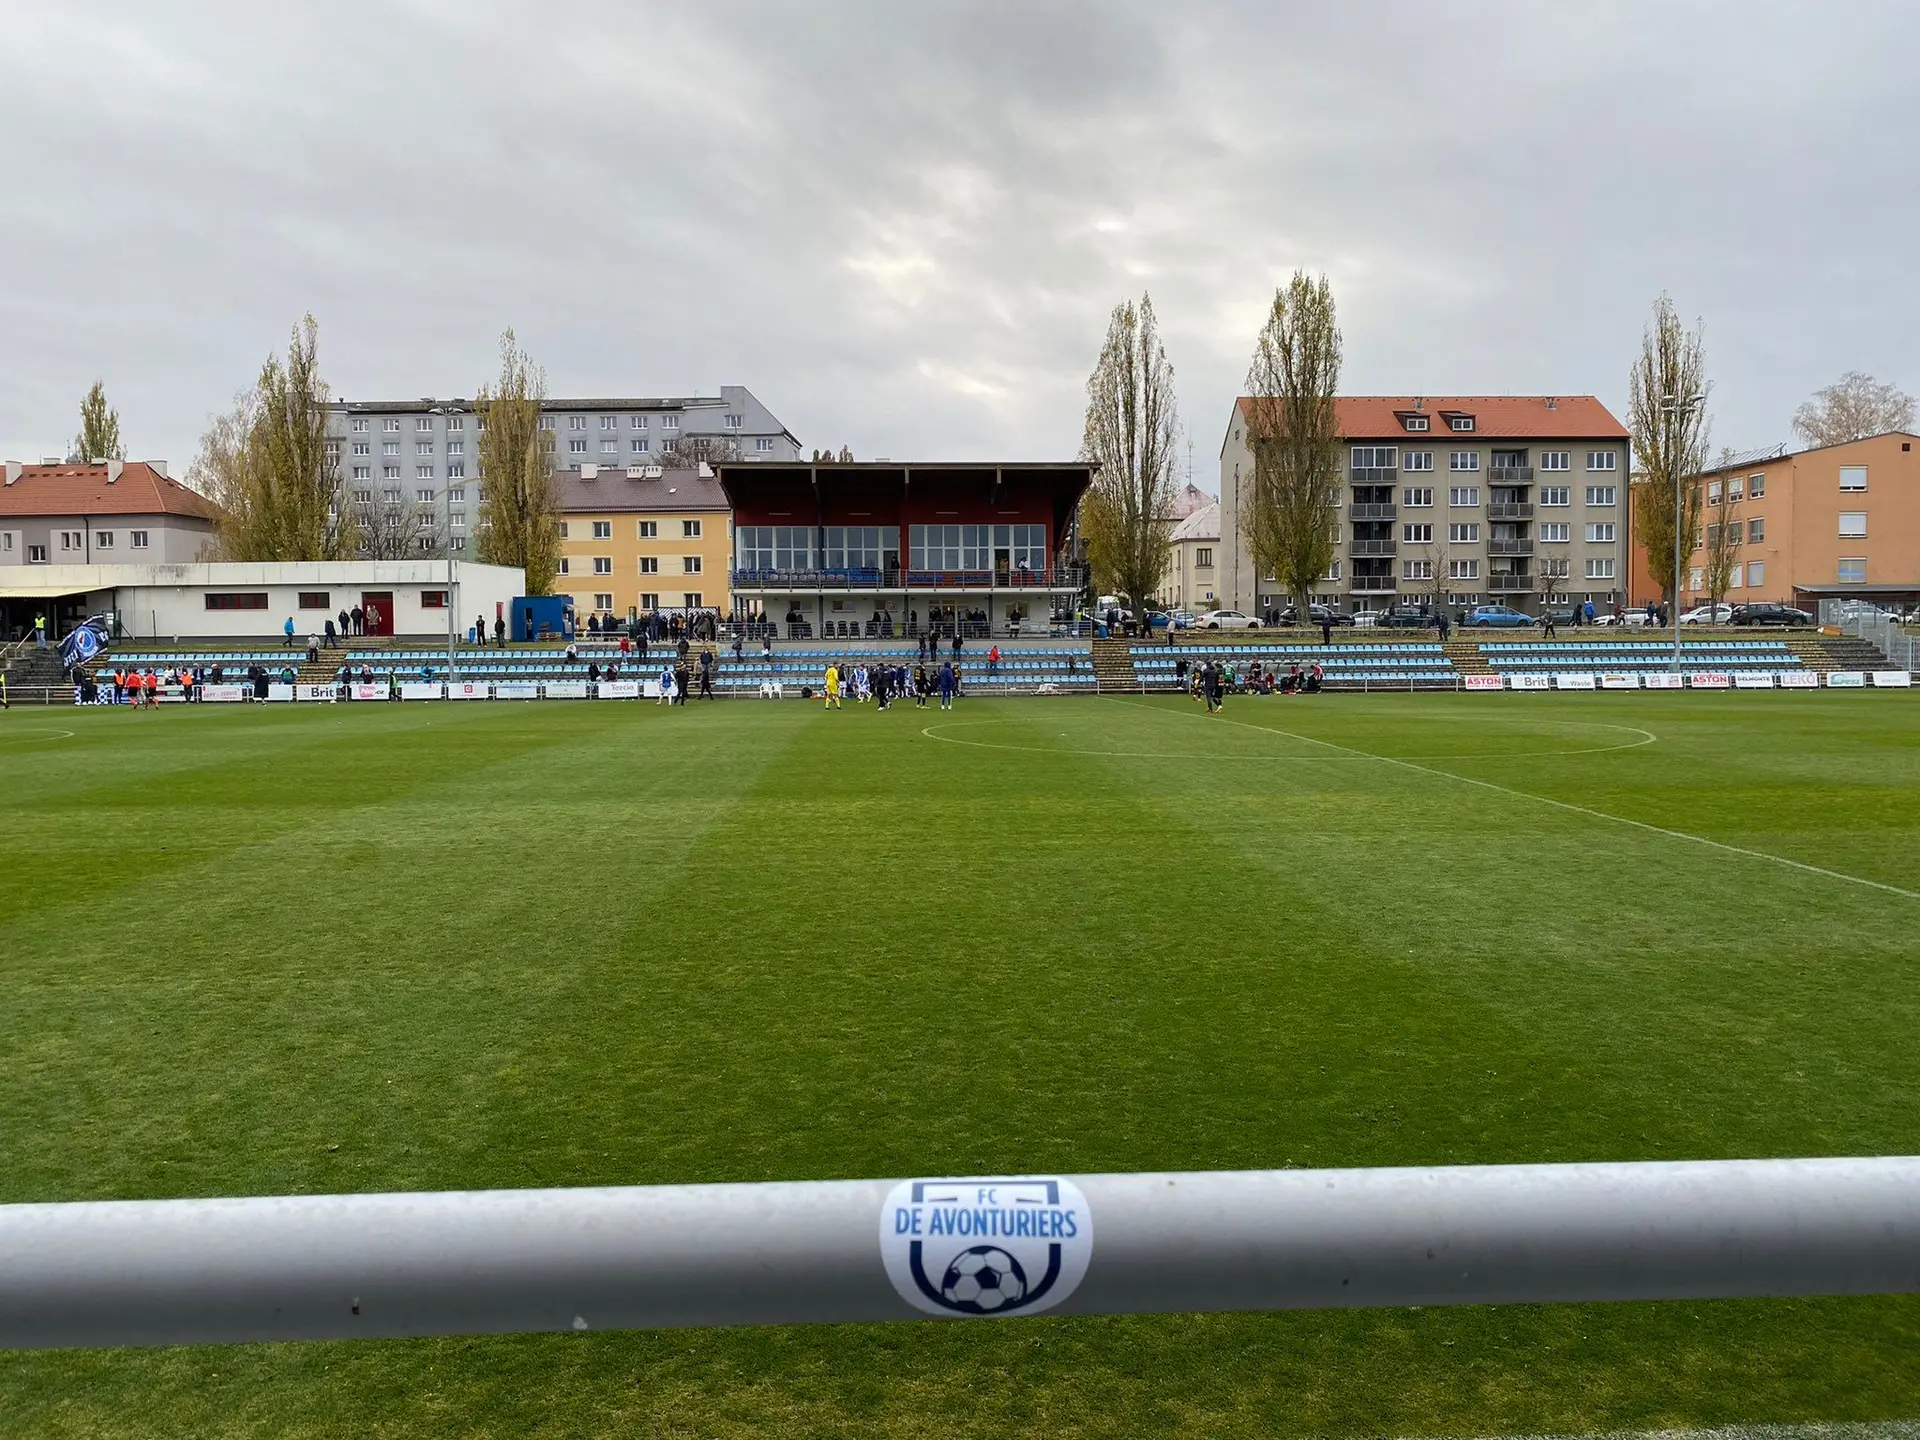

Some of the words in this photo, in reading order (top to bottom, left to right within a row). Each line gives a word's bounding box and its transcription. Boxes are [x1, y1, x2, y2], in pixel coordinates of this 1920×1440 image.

[1524, 677, 1545, 686] Brit
[1693, 675, 1728, 683] ASTON
[311, 686, 334, 697] Brit
[977, 1188, 997, 1205] FC
[895, 1208, 922, 1235] DE
[928, 1208, 1077, 1238] AVONTURIERS
